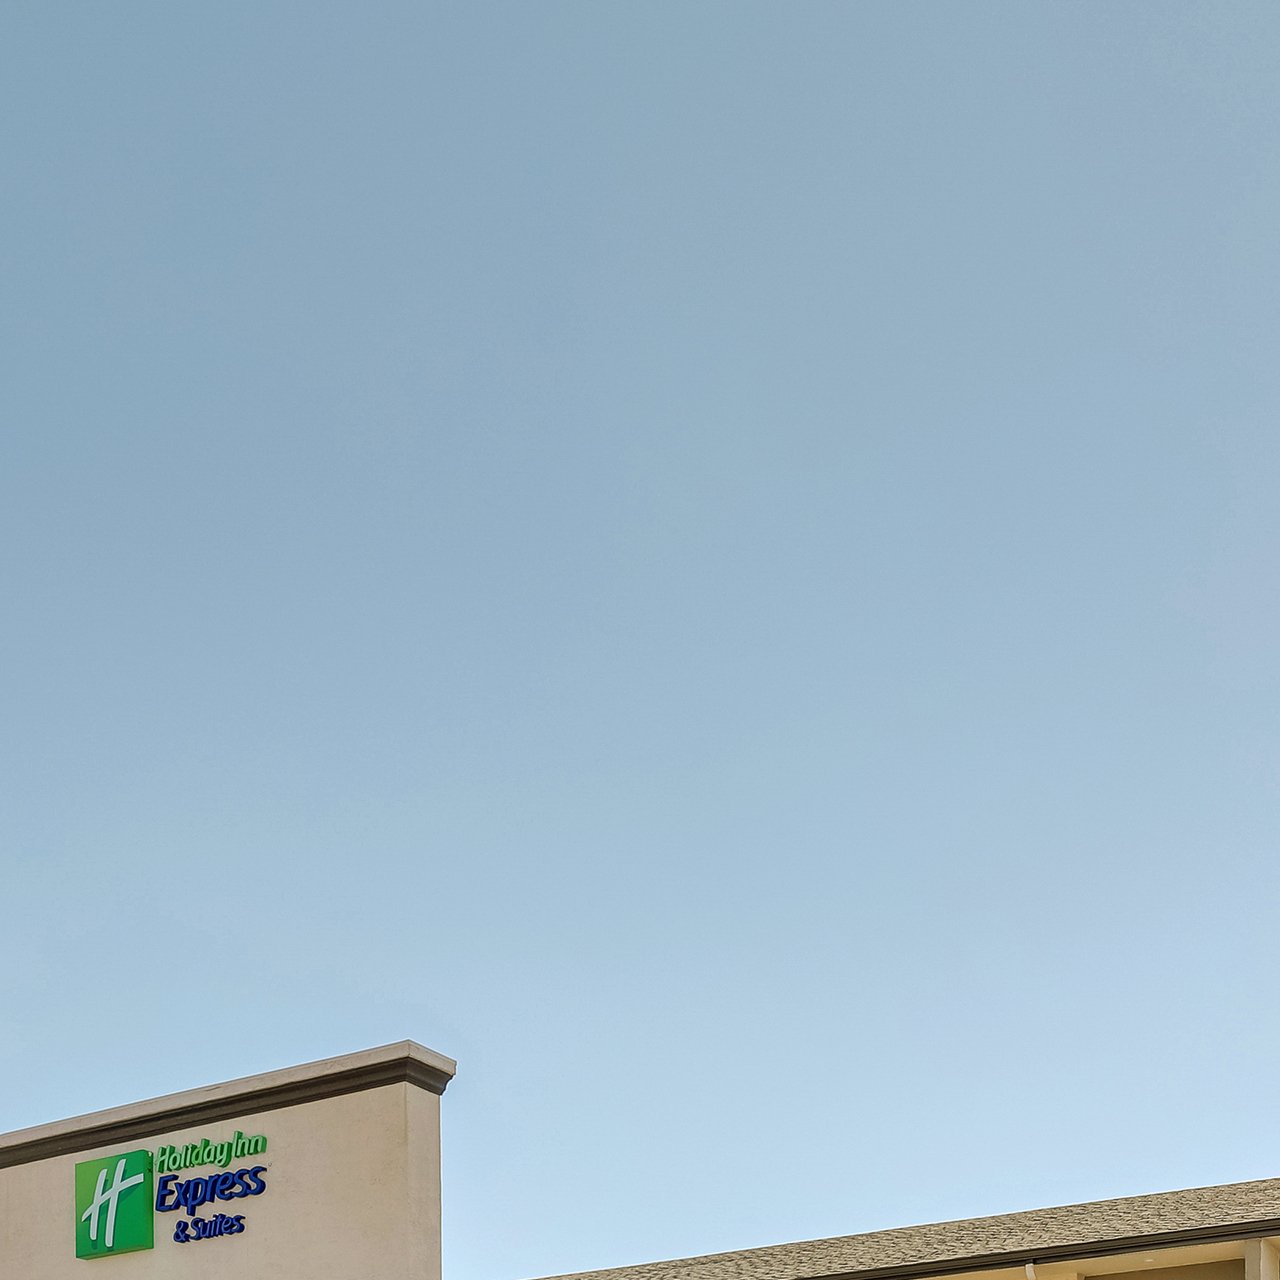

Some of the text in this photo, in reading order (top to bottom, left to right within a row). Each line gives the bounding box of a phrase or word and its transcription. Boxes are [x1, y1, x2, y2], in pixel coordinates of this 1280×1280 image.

[157, 1130, 267, 1174] Holiday Inn
[155, 1165, 267, 1217] Express
[173, 1213, 246, 1243] & Suites
